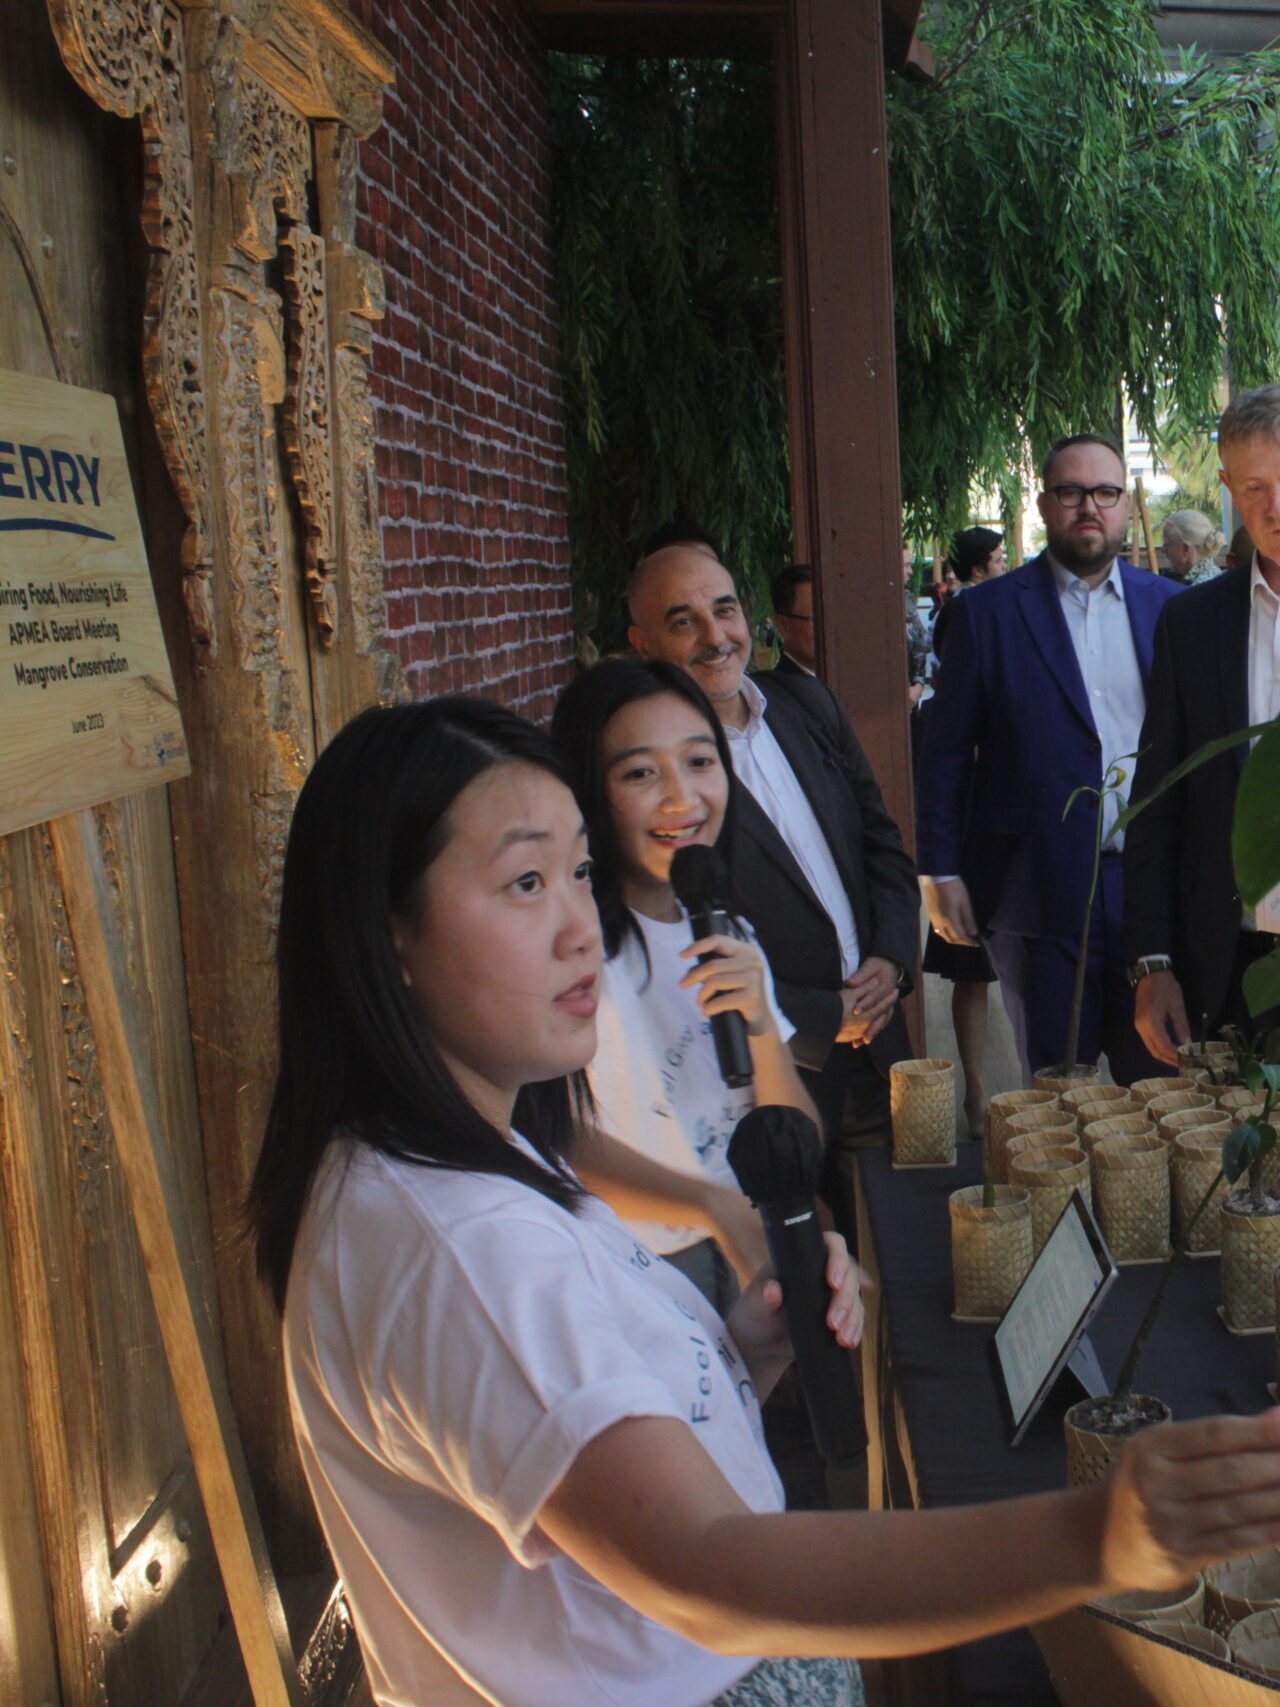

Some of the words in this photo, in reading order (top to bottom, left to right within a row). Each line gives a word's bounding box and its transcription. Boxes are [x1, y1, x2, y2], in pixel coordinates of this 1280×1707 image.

[0, 581, 28, 610] iring
[28, 582, 60, 608] Food,
[58, 582, 111, 607] Nourishing
[110, 582, 128, 603] Life
[8, 620, 51, 646] APMEA
[50, 618, 82, 642] Board
[82, 617, 121, 642] Meeting
[13, 662, 69, 689] Mangrove
[68, 652, 129, 679] Conservation
